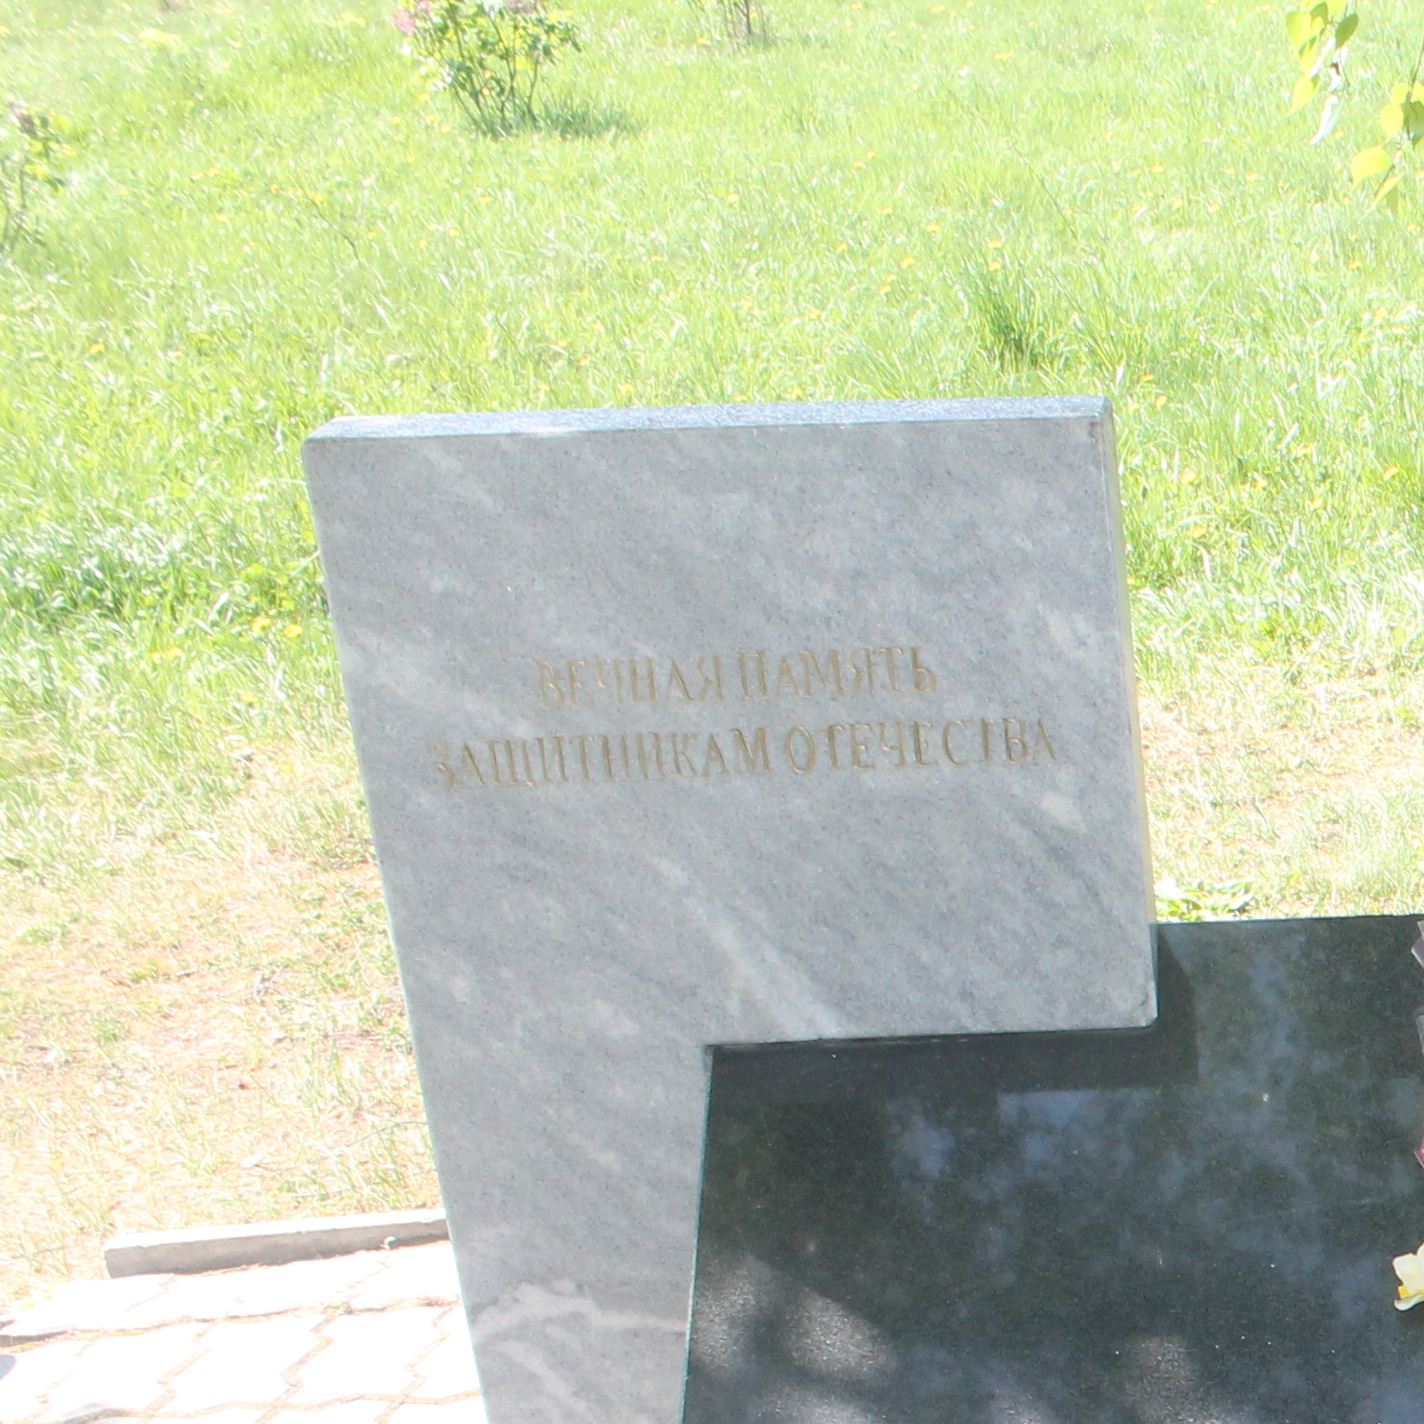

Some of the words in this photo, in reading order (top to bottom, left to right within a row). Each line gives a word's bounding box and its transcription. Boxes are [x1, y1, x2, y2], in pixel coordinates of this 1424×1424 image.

[533, 653, 724, 710] ВЕЧНАЯ
[736, 645, 939, 700] ПАМЯТЬ
[429, 727, 772, 792] ЗАЩИТНИКАМ
[783, 716, 1060, 773] ОТЕЧЕСТВА
